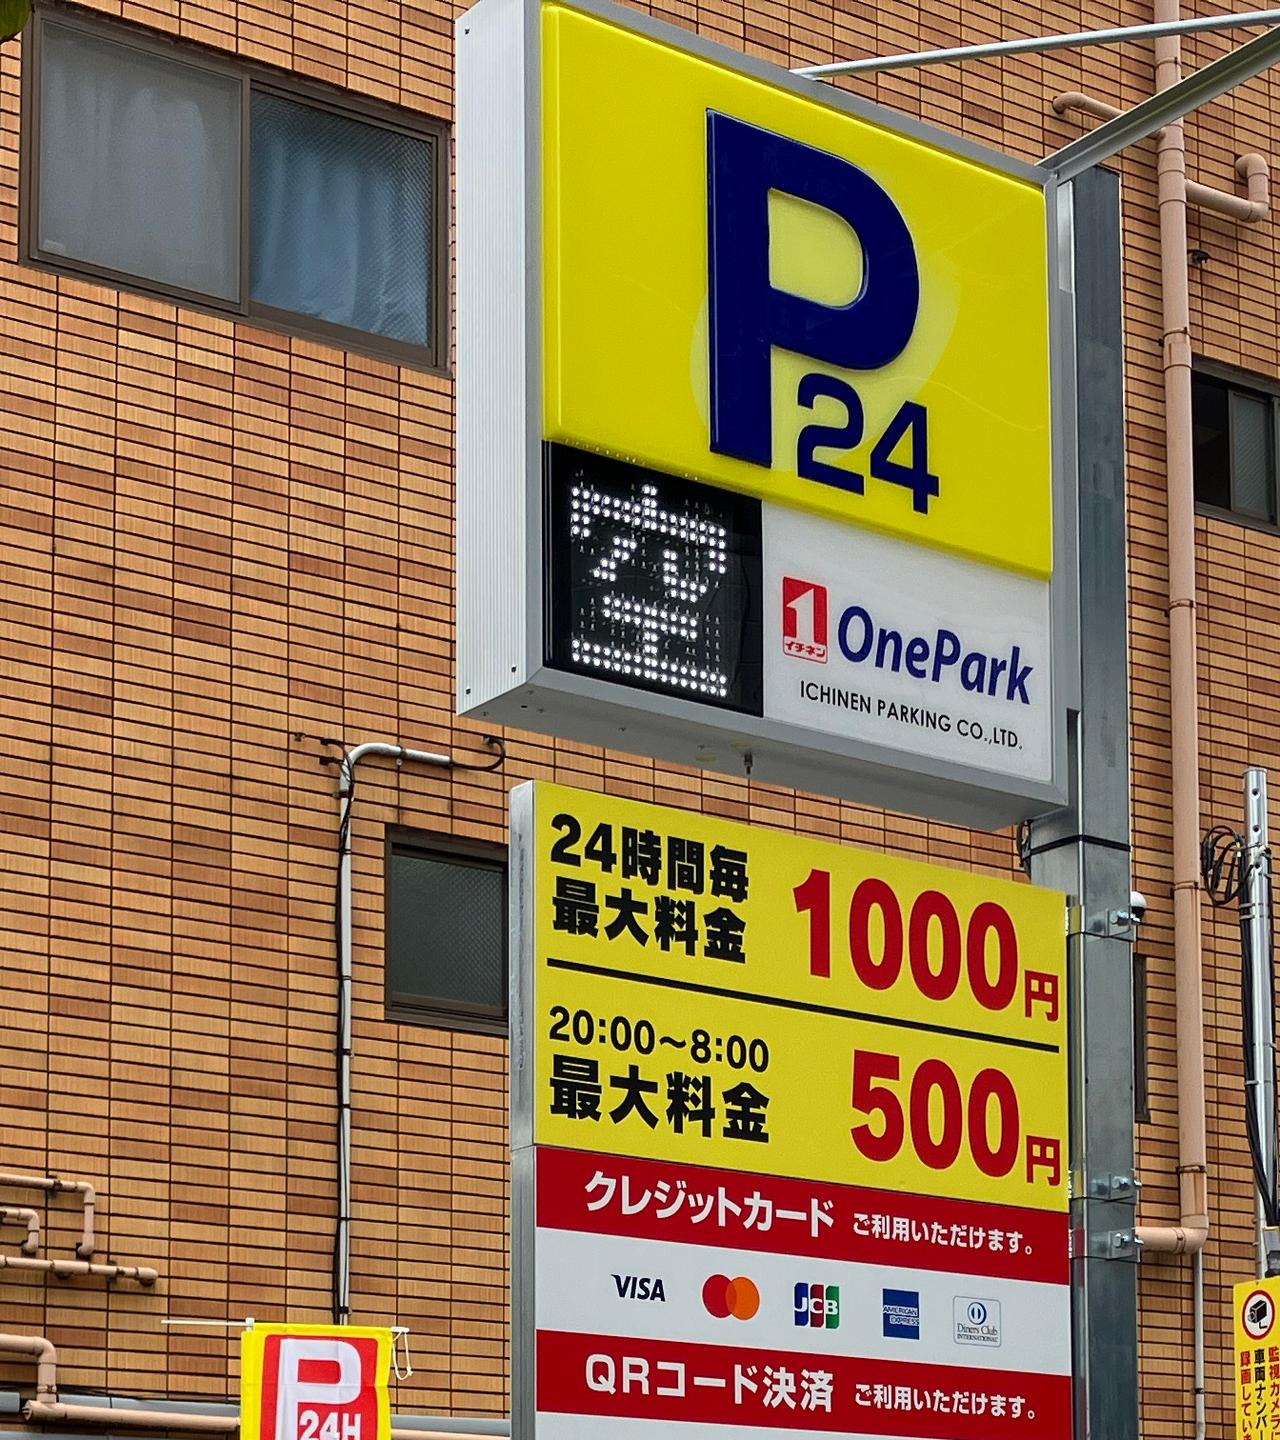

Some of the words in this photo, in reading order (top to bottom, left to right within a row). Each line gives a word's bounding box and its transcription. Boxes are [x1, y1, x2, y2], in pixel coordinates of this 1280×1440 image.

[706, 107, 920, 469] P
[796, 372, 940, 515] 24
[570, 484, 728, 697] 空
[784, 640, 827, 660] イチネン
[837, 605, 1034, 705] OnePark
[800, 680, 871, 714] ICHINEN
[877, 699, 952, 733] PARKING
[956, 719, 1023, 750] CO.,LTD.
[549, 813, 750, 904] 24時間毎
[551, 875, 747, 964] 最大料金
[792, 868, 1061, 1022] 1000円
[549, 1053, 770, 1144] 最大料金
[850, 1048, 1062, 1187] 500円
[584, 1169, 836, 1238] クレジットカード
[852, 1210, 1034, 1256] ご利用いただけます。
[611, 1273, 666, 1304] VISA
[956, 1323, 980, 1334] Diners
[981, 1325, 999, 1336] Club
[585, 1353, 835, 1413] QRコード決済
[854, 1383, 1037, 1421] ご利用いただけます。
